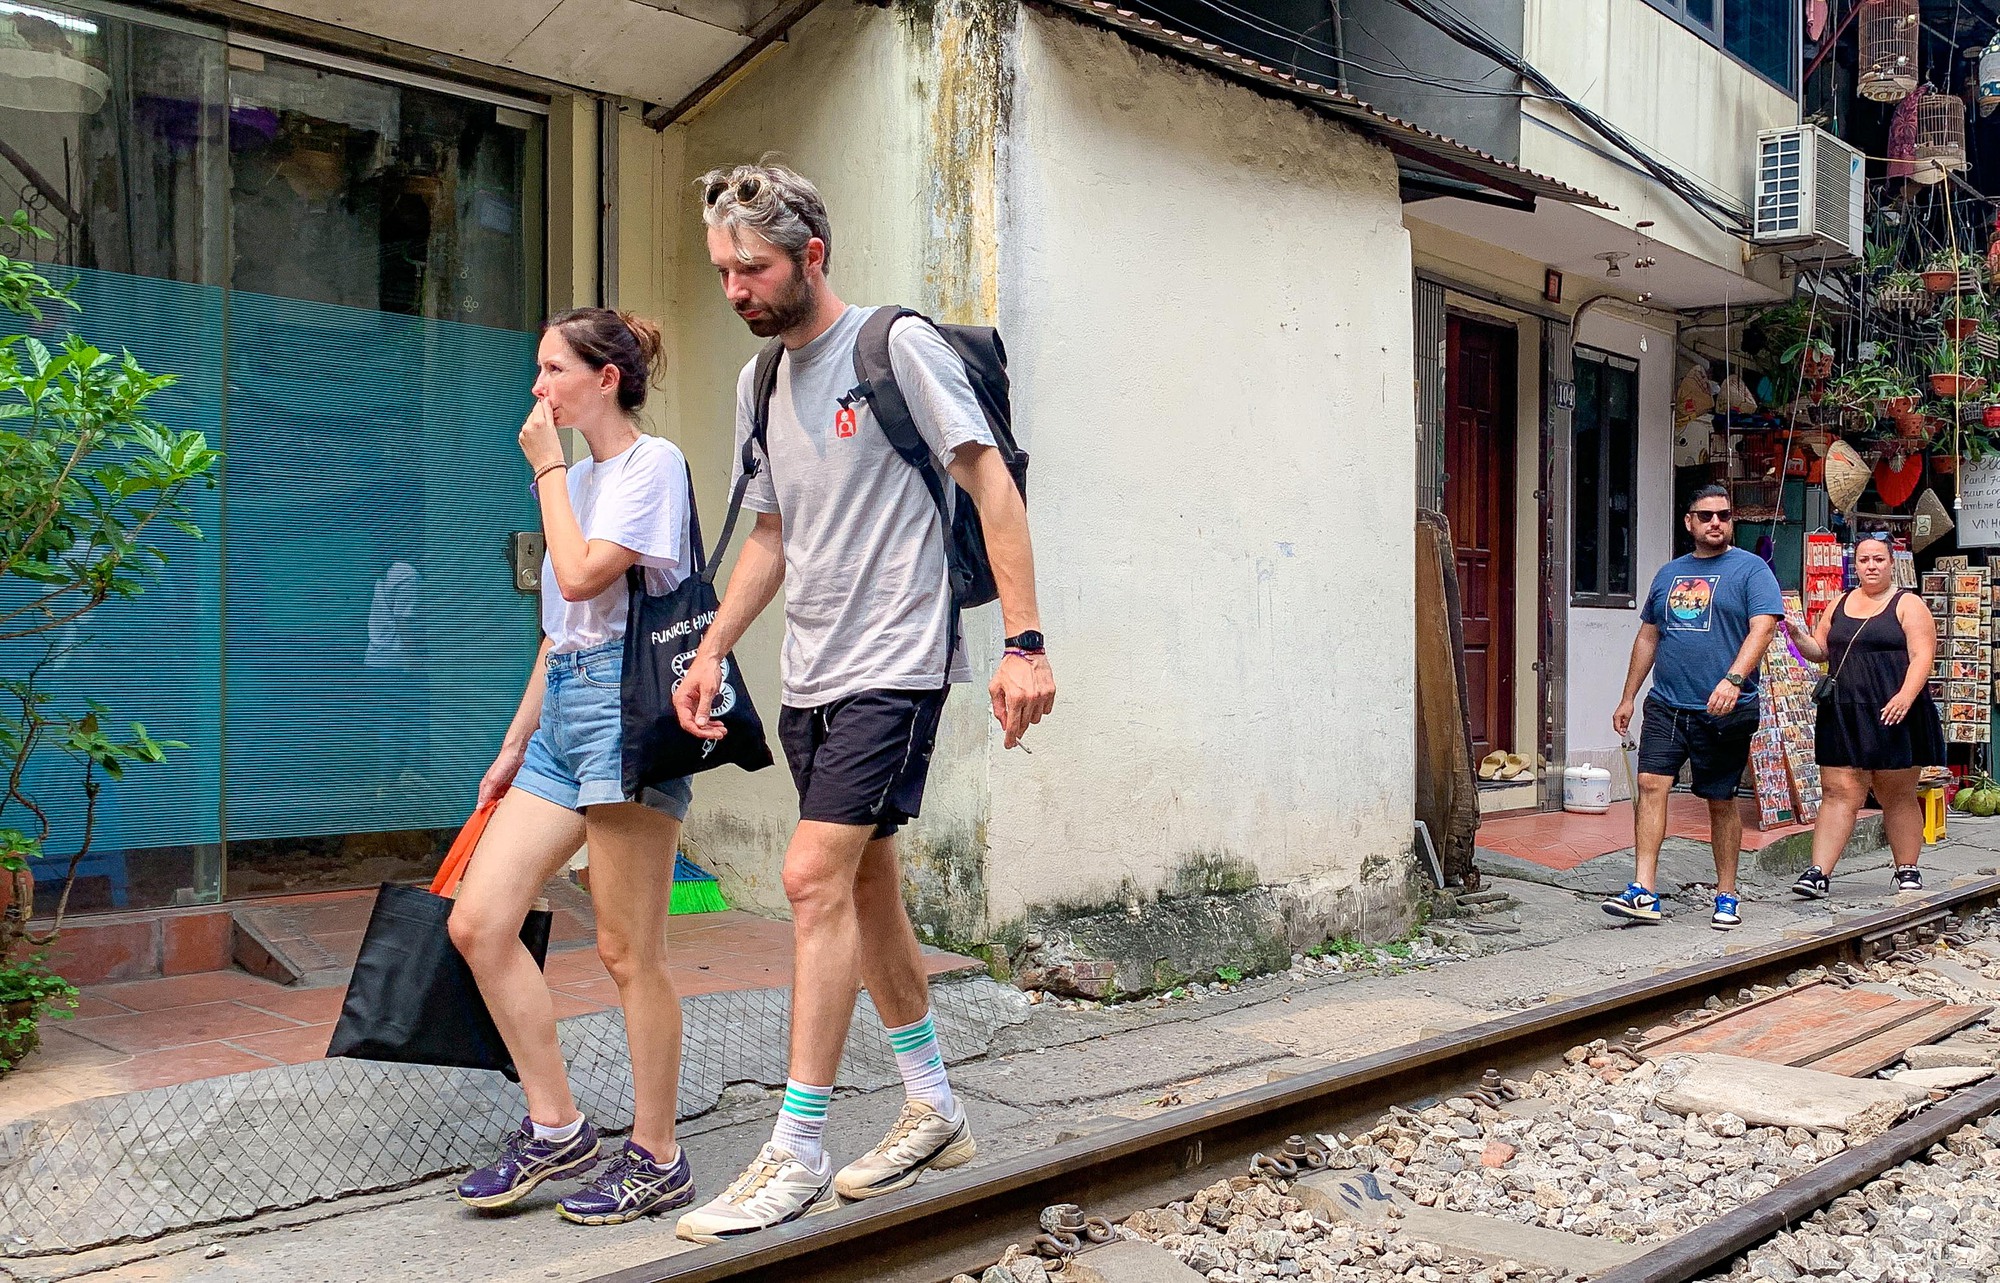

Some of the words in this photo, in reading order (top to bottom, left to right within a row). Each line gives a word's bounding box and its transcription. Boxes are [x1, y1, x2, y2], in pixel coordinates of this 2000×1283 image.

[1559, 385, 1573, 405] 104
[1972, 518, 1988, 529] VN
[1991, 518, 2000, 528] H
[651, 620, 692, 645] FUNKIE
